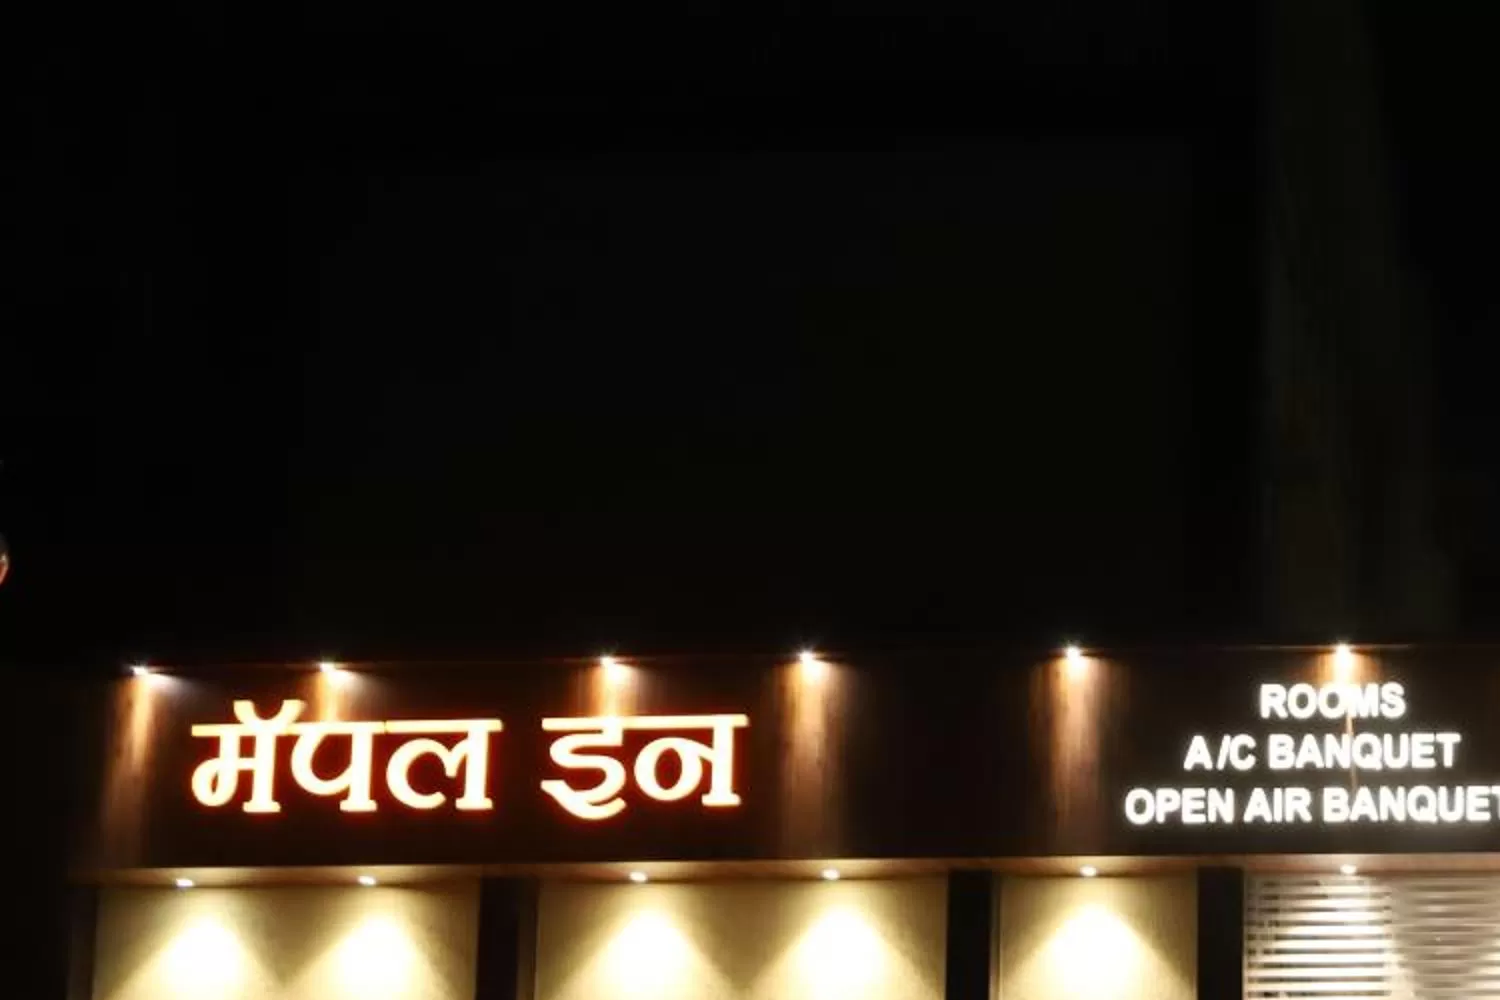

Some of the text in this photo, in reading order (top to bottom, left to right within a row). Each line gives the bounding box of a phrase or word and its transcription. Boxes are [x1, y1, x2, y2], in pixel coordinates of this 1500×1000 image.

[1260, 682, 1406, 719] ROOMS
[191, 699, 747, 819] मॅपल इन
[1183, 732, 1461, 771] A/C BANQUET
[1125, 788, 1234, 824] OPEN
[1243, 787, 1313, 822] AIR
